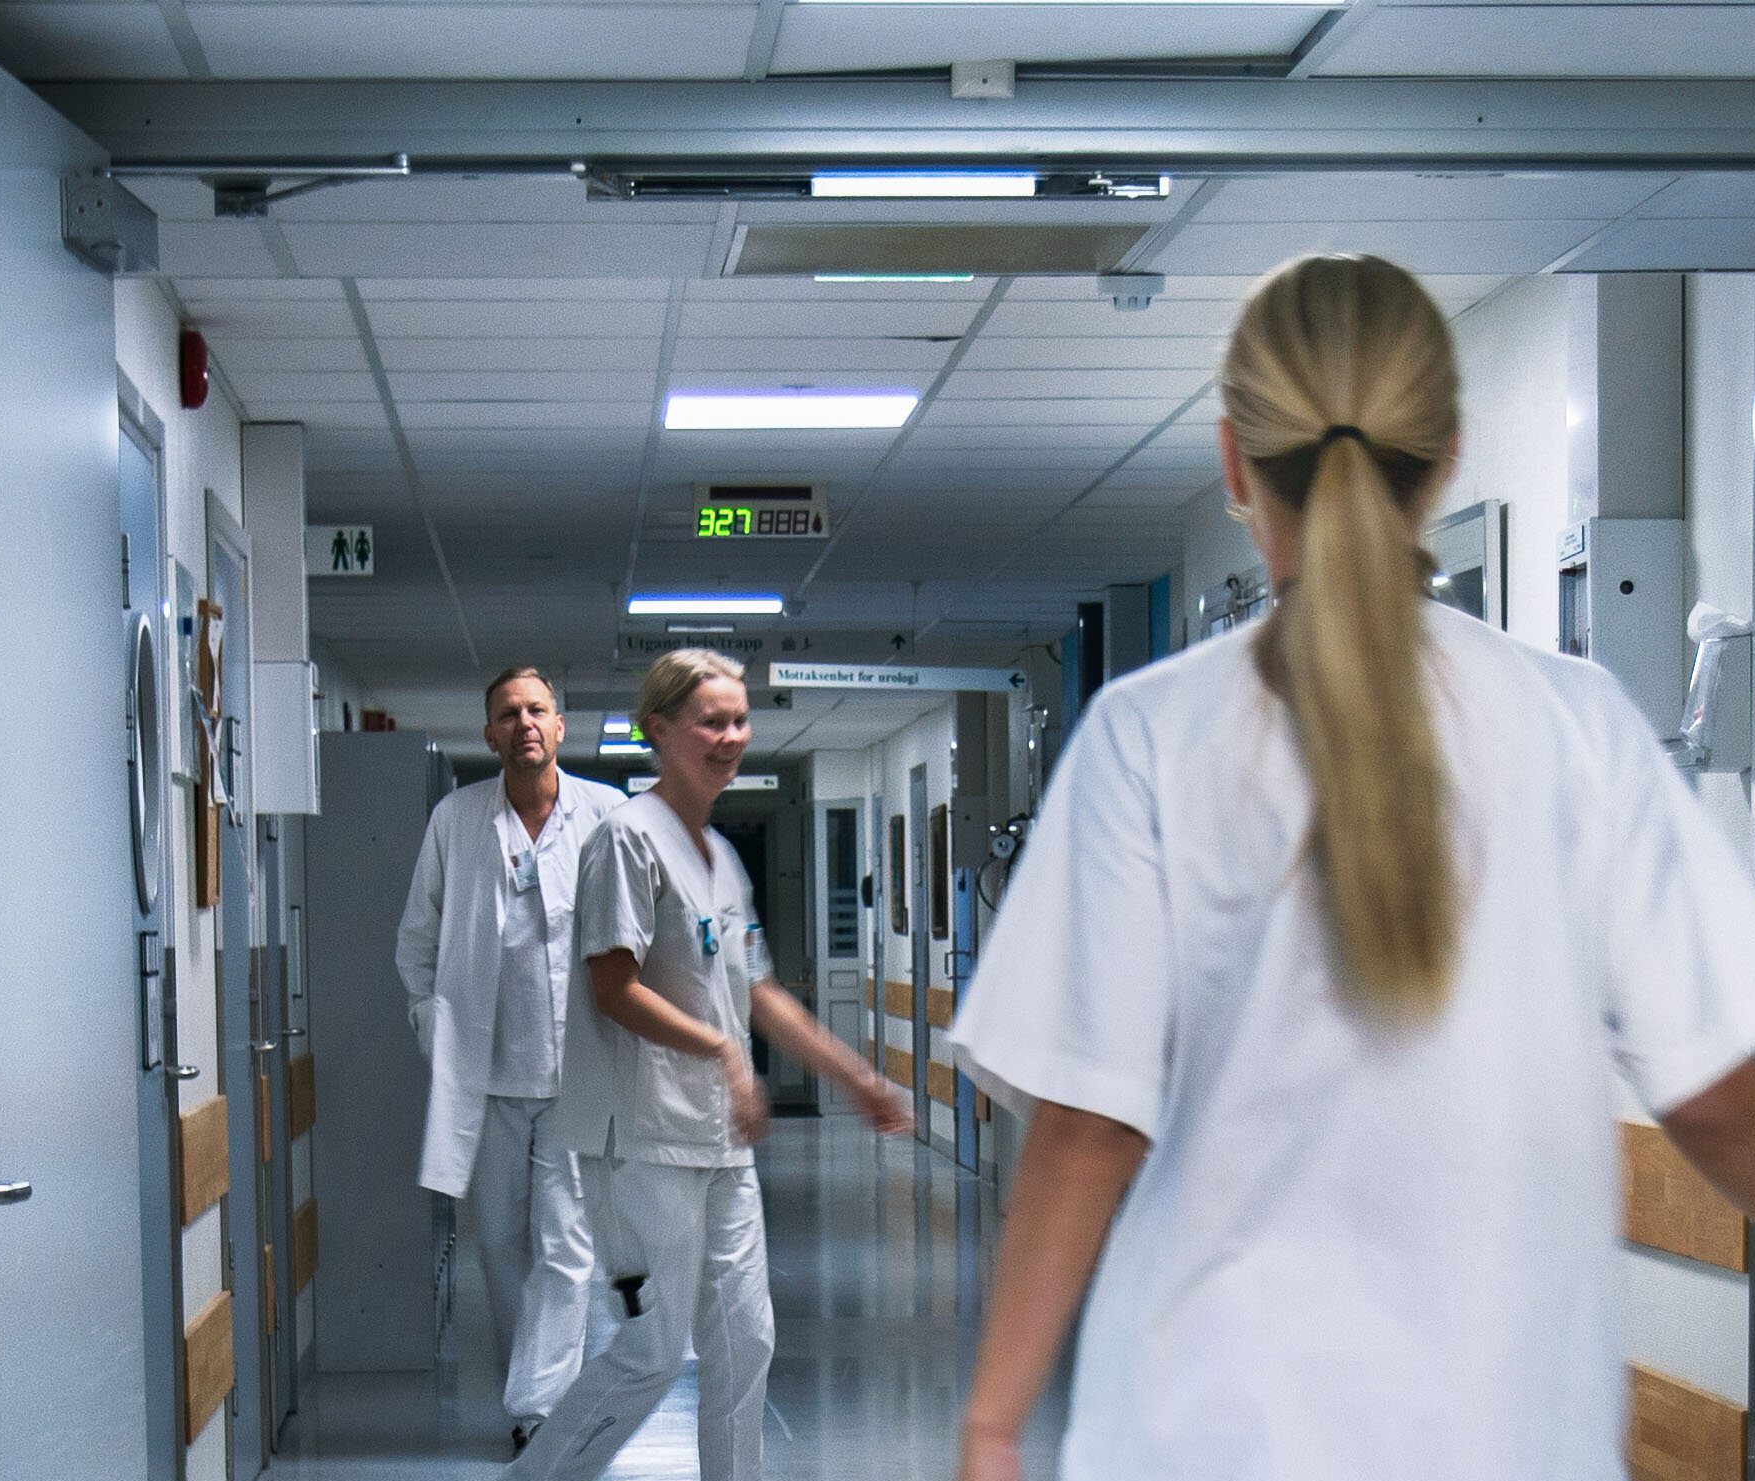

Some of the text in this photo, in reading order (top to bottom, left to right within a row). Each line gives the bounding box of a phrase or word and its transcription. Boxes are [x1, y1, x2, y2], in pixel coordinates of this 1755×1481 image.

[698, 508, 752, 536] 327
[627, 635, 763, 651] Utgang heis/trapp
[777, 668, 919, 686] Mottaksenhet for urologi
